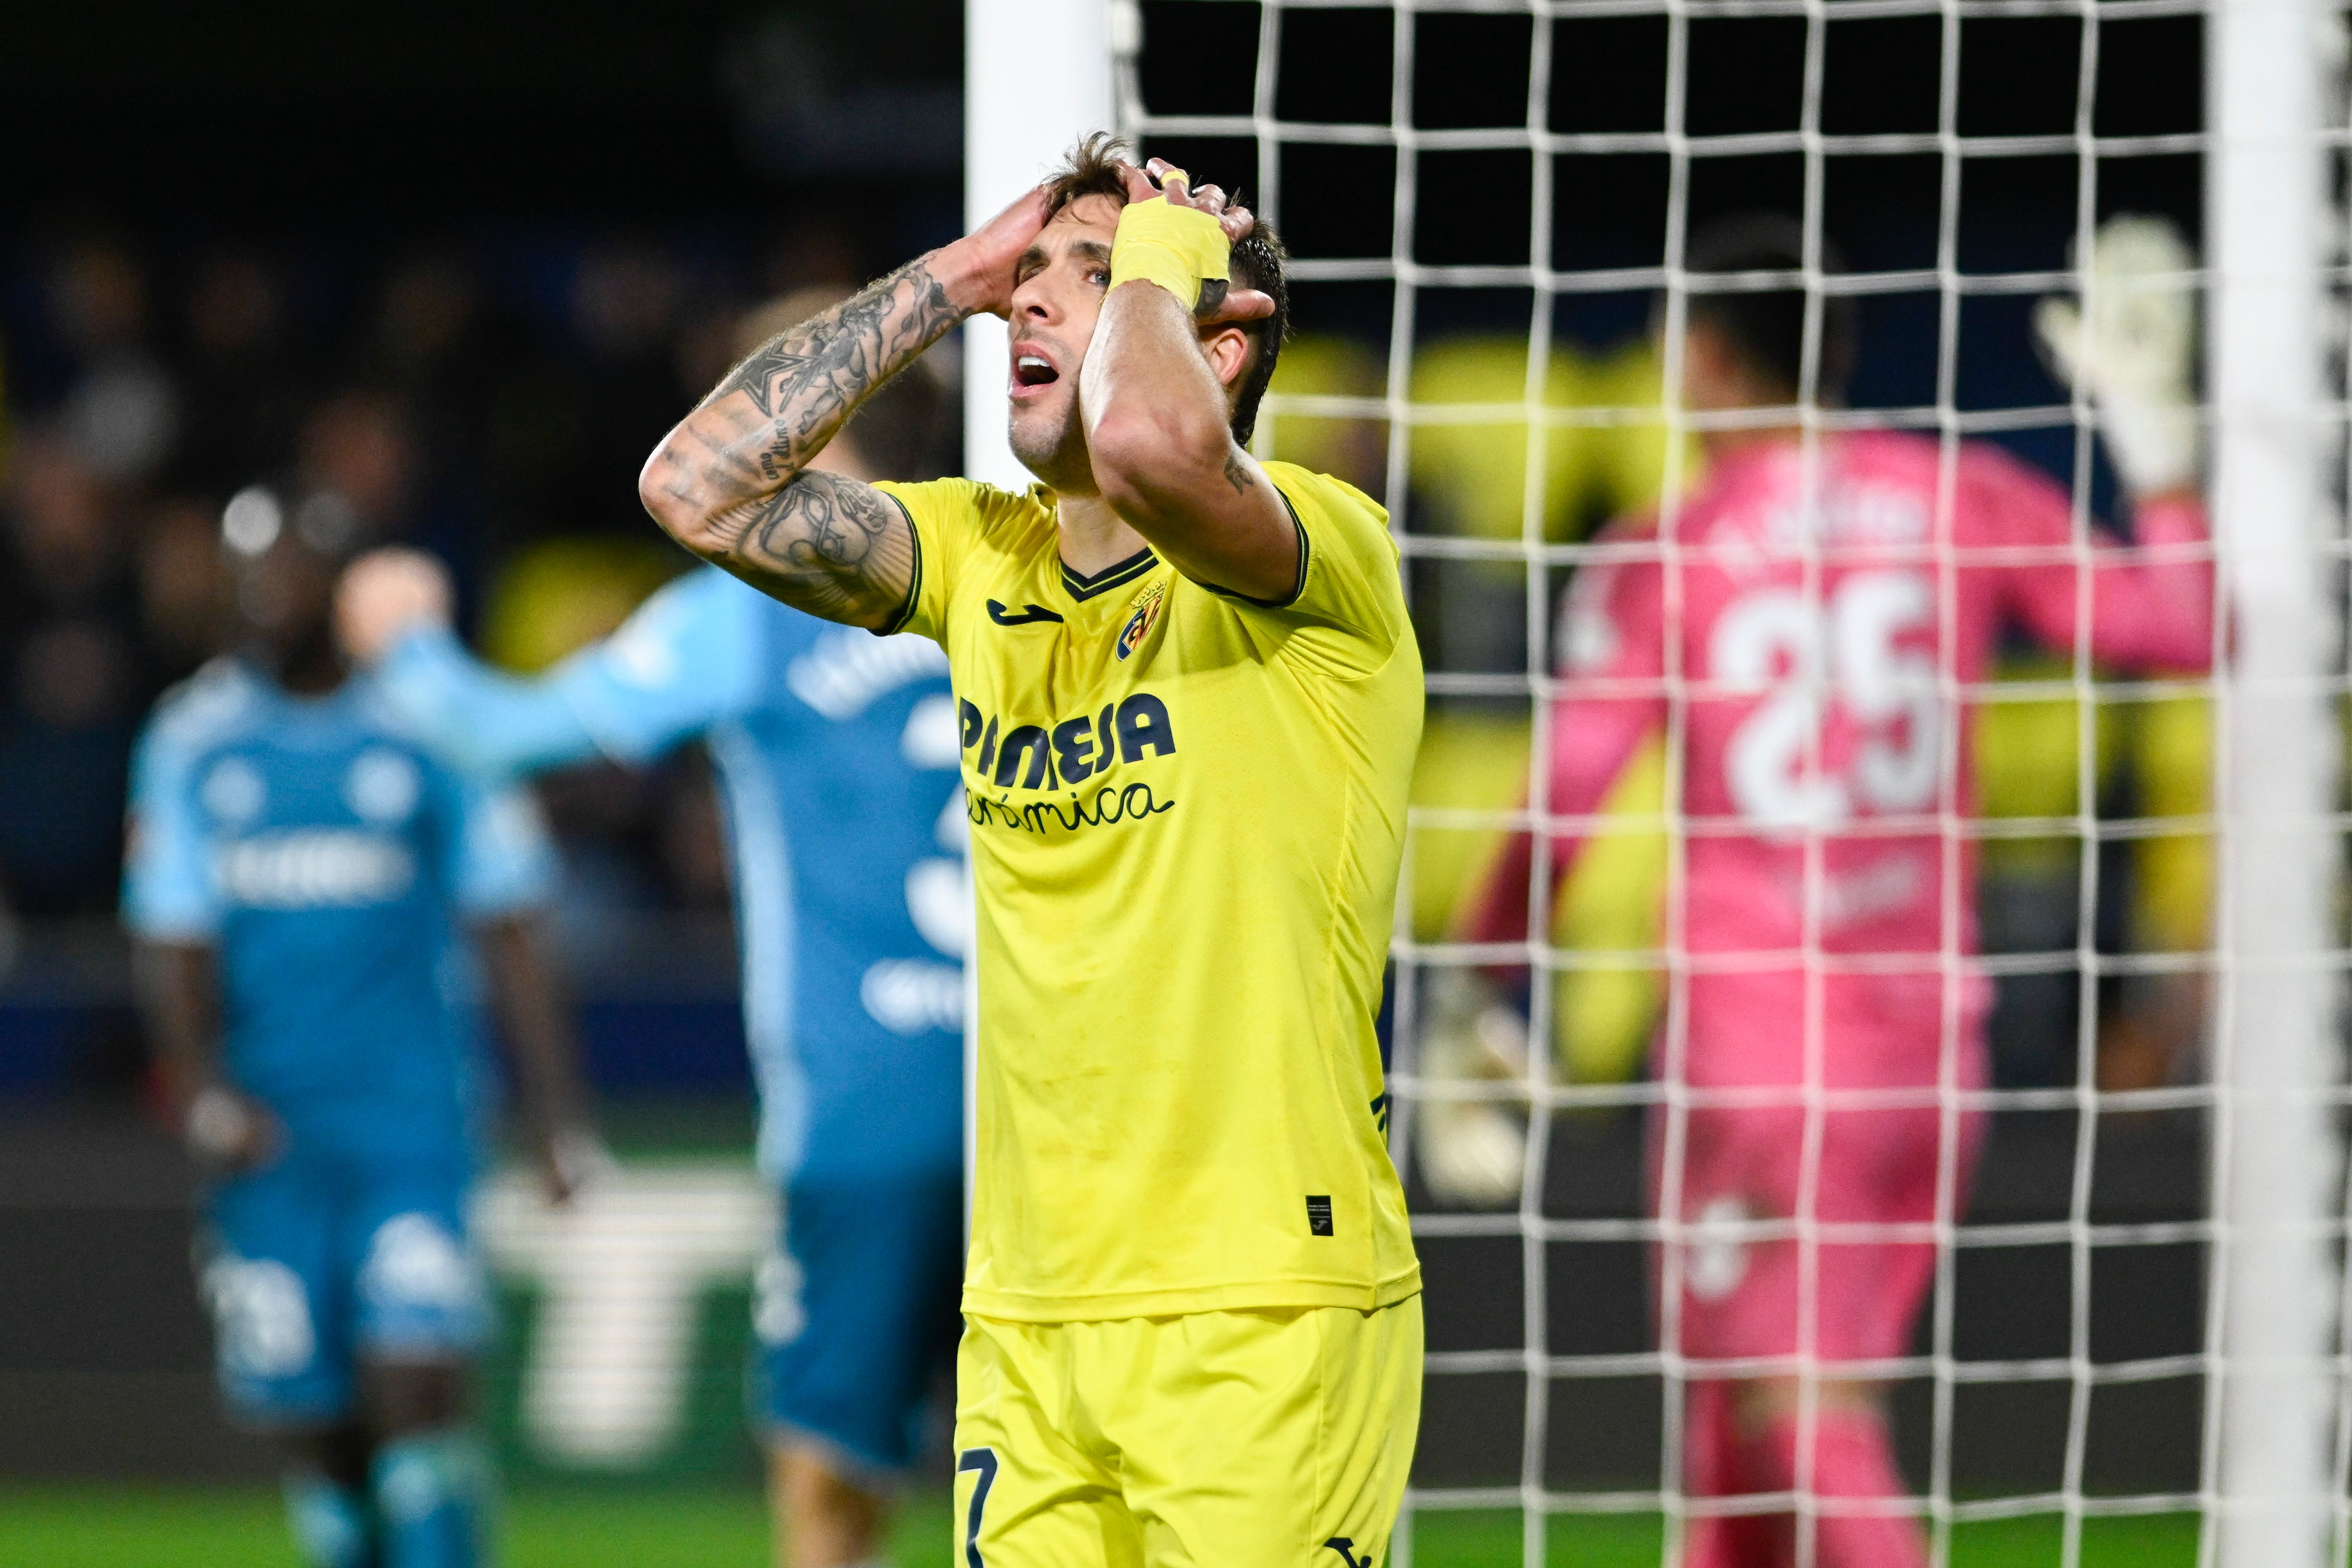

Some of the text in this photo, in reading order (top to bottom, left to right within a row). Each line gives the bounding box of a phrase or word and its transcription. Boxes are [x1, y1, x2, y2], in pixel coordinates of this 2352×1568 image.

[1708, 567, 1945, 840] 25
[965, 782, 1175, 834] erámica
[957, 1446, 998, 1568] 7
